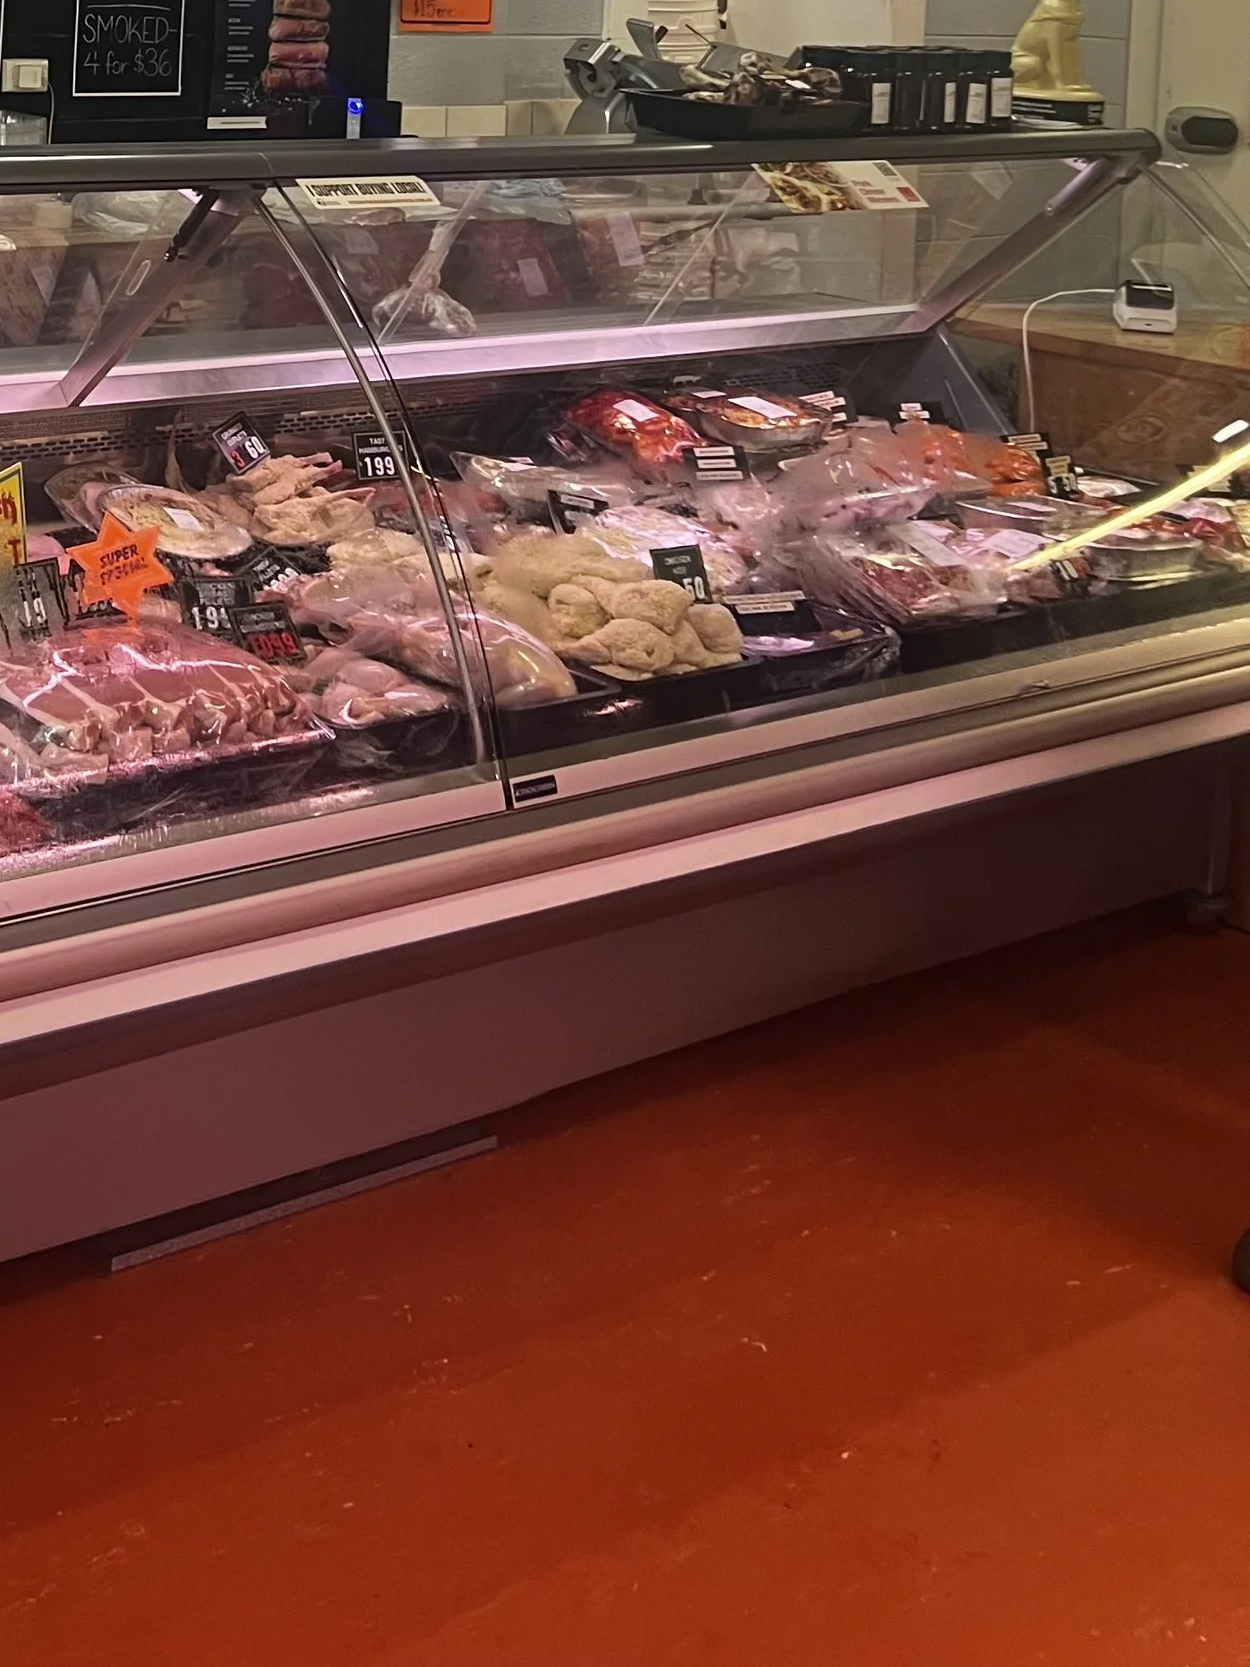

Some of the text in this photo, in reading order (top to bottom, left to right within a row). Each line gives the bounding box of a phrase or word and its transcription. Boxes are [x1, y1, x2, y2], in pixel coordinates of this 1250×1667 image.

[83, 48, 172, 77] 4 for $36
[305, 184, 316, 197] I
[310, 183, 359, 197] SUPPORT
[355, 182, 396, 195] BUYING
[369, 437, 386, 445] TAST
[100, 543, 140, 569] SUPER
